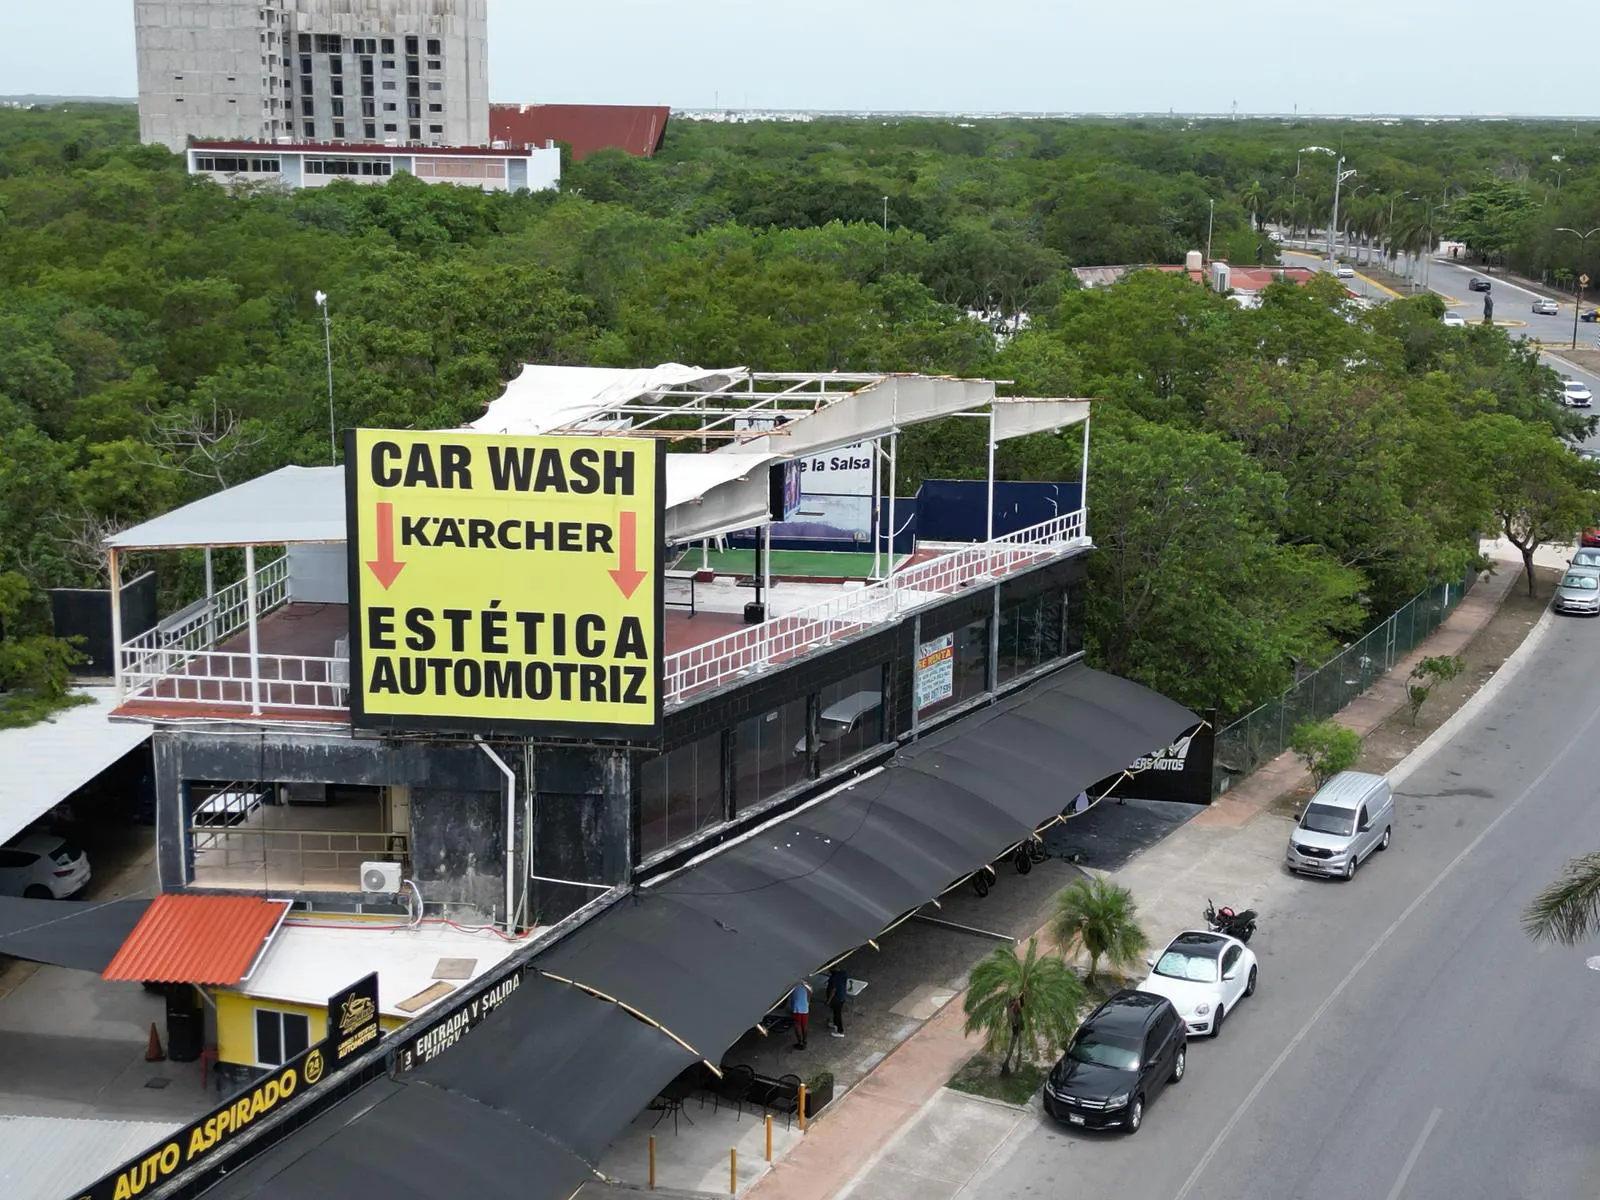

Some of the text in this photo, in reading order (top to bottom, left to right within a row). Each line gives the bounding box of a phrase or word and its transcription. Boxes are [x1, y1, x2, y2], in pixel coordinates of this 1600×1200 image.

[370, 441, 635, 496] CAR WASH
[812, 458, 825, 472] la
[830, 456, 871, 471] Salsa
[401, 515, 615, 553] KÄRCHER
[367, 599, 649, 660] ESTÉTICA
[368, 655, 648, 705] AUTOMOTRIZ
[1153, 758, 1185, 771] MOTOS
[416, 1008, 470, 1057] ENTRADA
[471, 1000, 479, 1018] Y
[482, 974, 520, 1011] SALIDA
[112, 1069, 297, 1200] AUTO ASPIRADO
